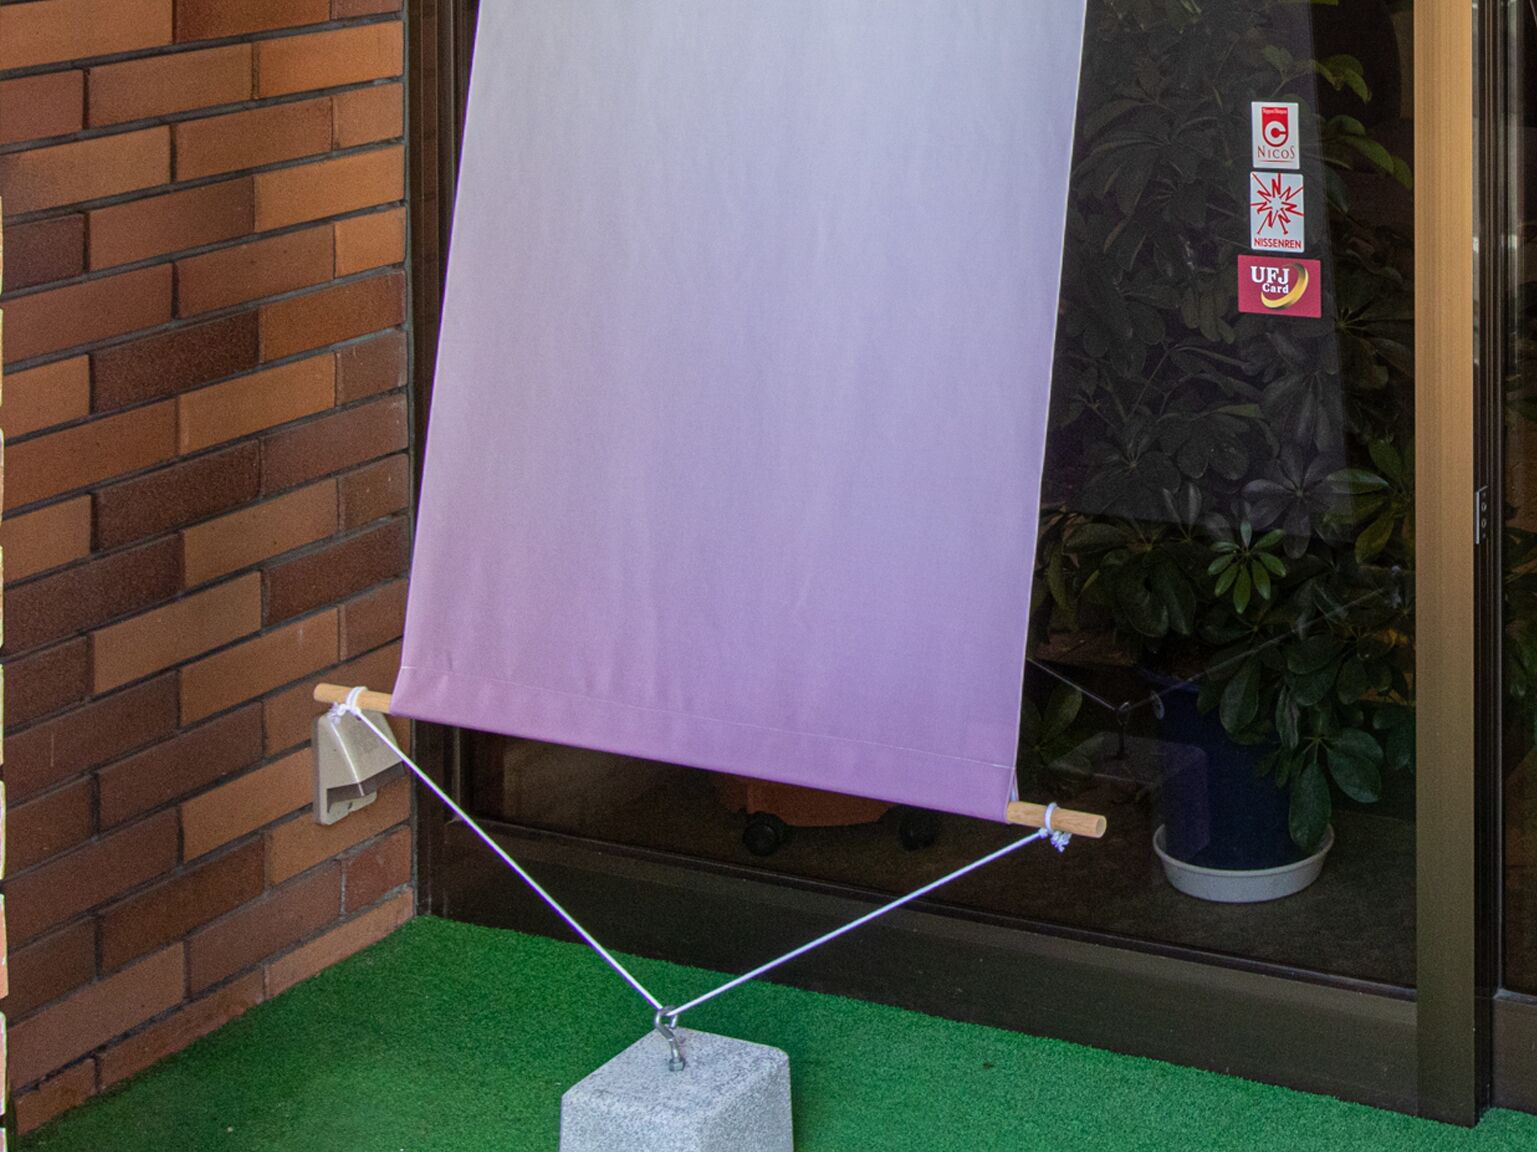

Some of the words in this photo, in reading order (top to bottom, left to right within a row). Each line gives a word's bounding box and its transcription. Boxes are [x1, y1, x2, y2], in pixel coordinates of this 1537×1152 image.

[1253, 237, 1302, 249] NISSENREN
[1250, 265, 1290, 284] UFJ
[1262, 283, 1290, 294] Card
